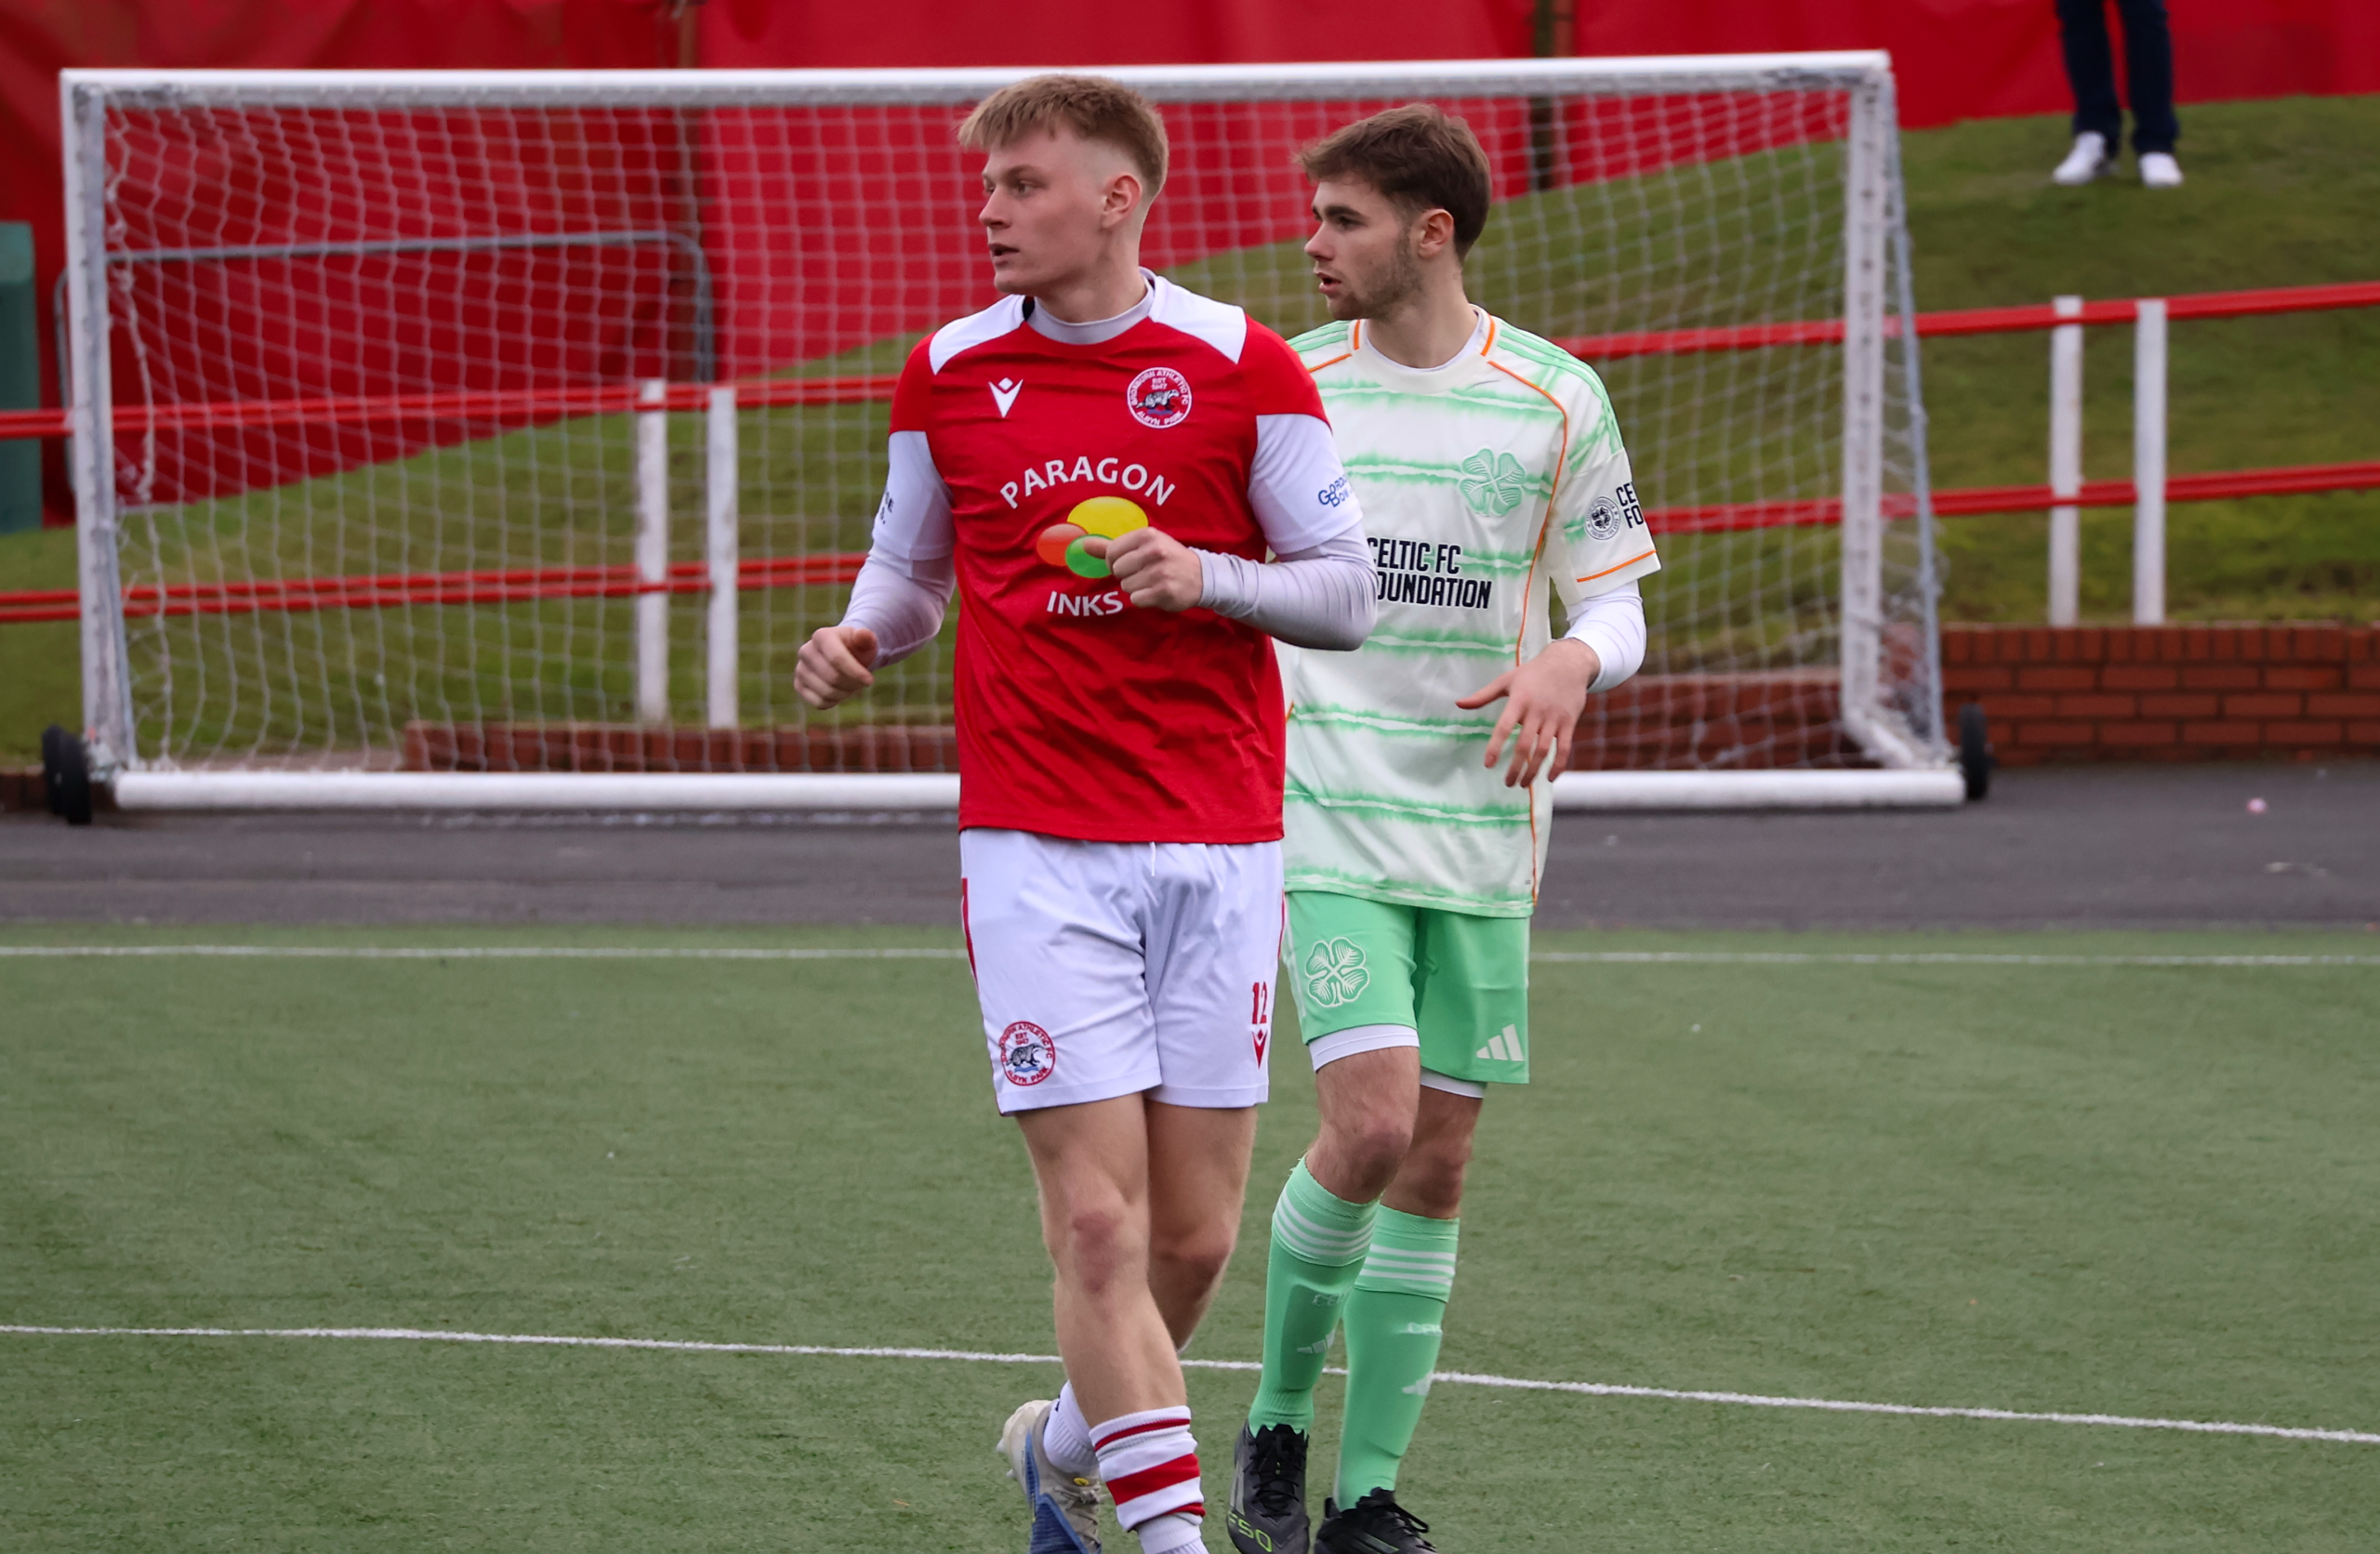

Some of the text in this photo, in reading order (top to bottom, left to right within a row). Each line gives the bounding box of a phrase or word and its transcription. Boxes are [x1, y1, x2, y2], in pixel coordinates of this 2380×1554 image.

[1157, 370, 1187, 393] ATHLETIC
[1181, 394, 1189, 405] FC
[999, 455, 1176, 509] PARAGON
[1367, 537, 1461, 574] CELTIC FC
[1046, 590, 1124, 616] INKS
[1377, 571, 1492, 609] OUNDATION
[1251, 981, 1268, 1025] 12
[1045, 1047, 1053, 1059] FC
[1227, 1510, 1273, 1552] F50
